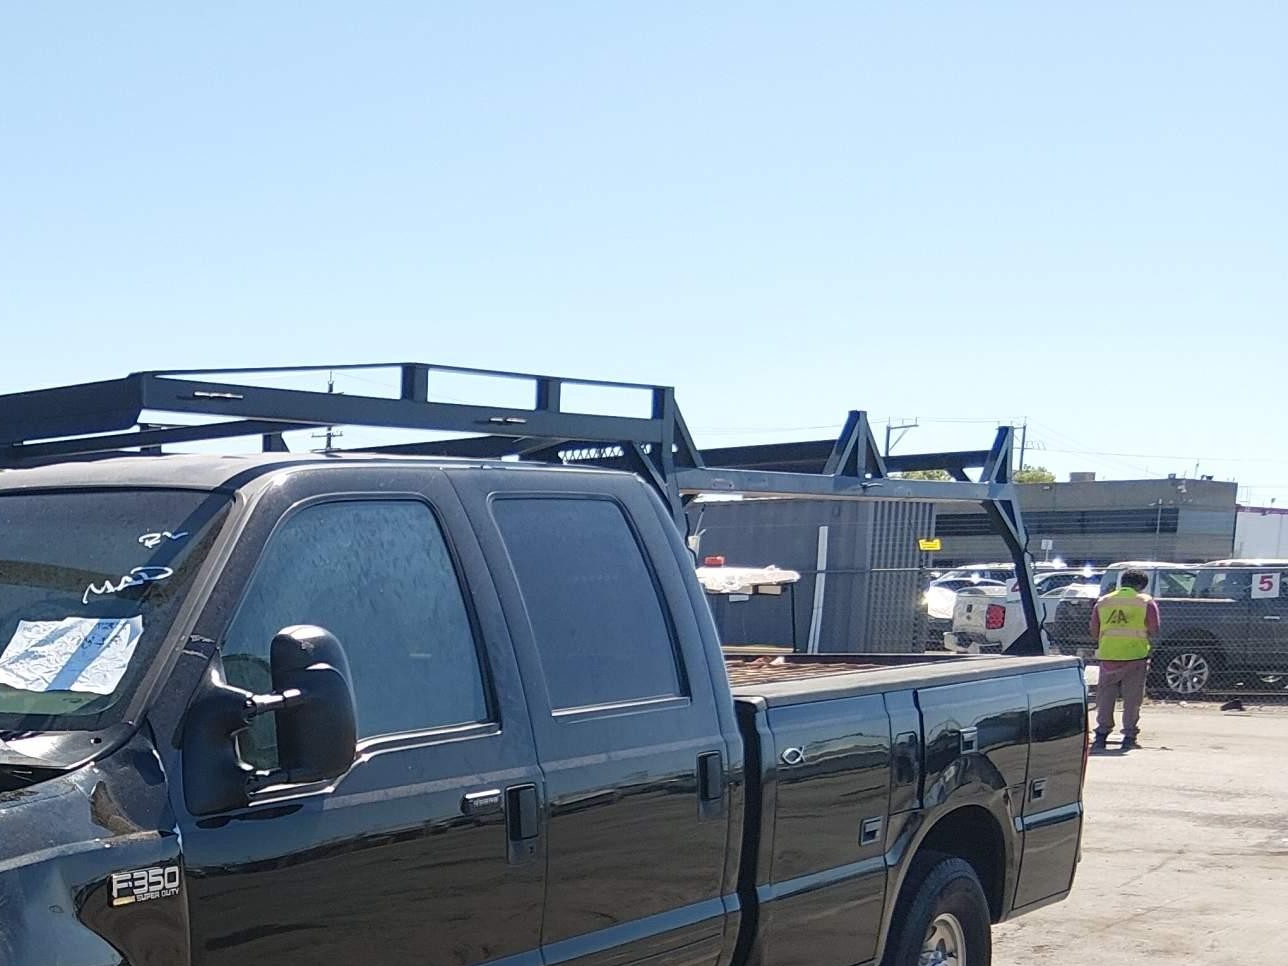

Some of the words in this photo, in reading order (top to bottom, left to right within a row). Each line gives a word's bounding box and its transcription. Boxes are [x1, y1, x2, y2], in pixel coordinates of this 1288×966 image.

[1257, 575, 1274, 592] 5
[135, 891, 160, 902] SUPER
[161, 888, 180, 897] DUTY
